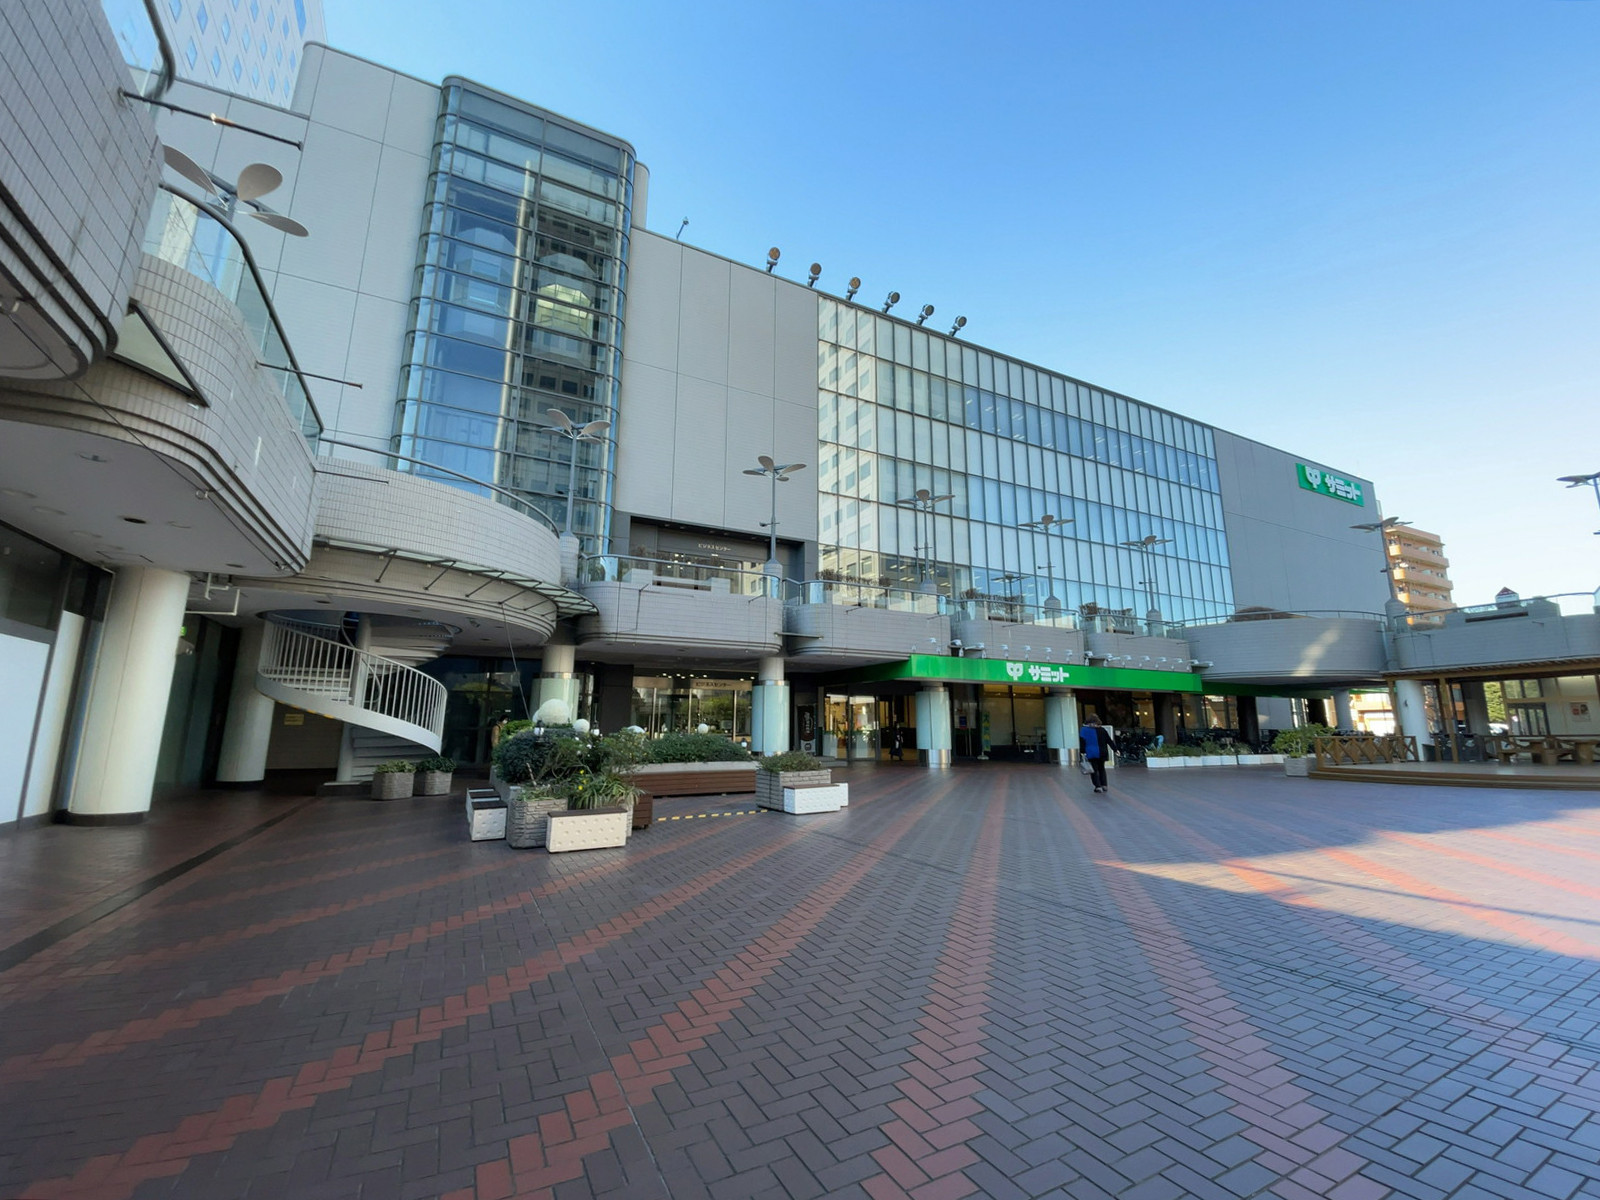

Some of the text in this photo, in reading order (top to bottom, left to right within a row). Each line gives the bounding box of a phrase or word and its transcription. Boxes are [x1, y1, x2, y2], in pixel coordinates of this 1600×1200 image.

[1325, 474, 1361, 500] サミット
[1029, 665, 1069, 683] サミット
